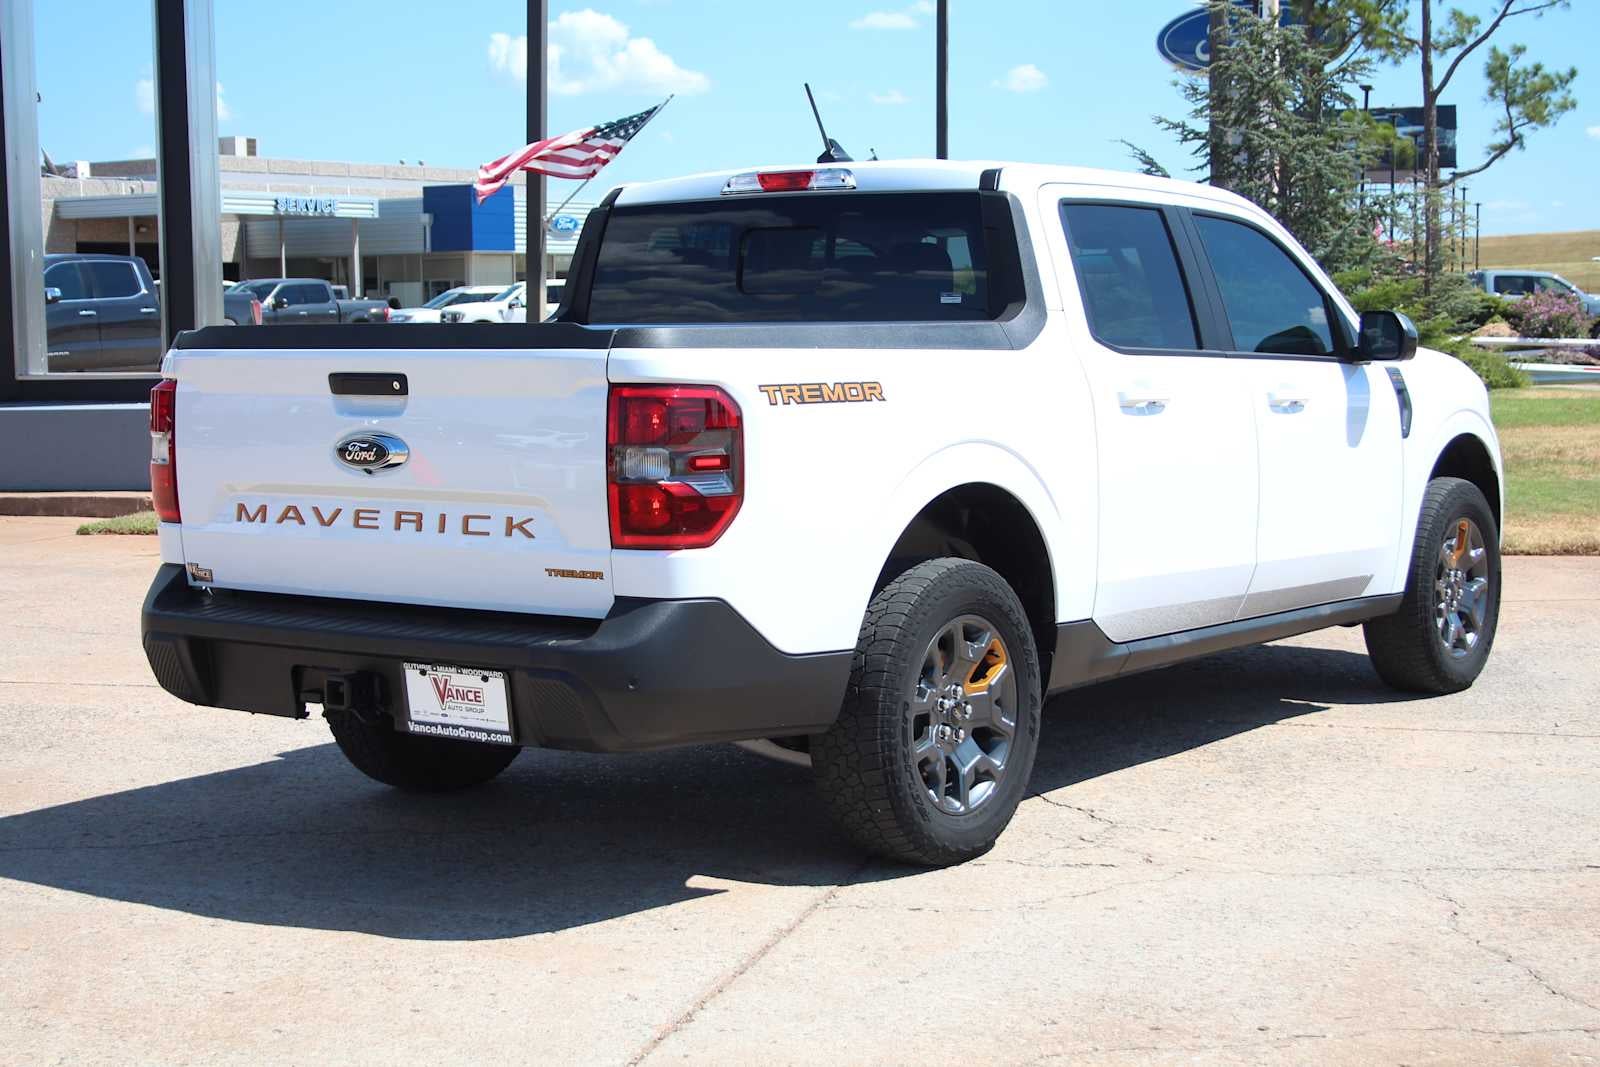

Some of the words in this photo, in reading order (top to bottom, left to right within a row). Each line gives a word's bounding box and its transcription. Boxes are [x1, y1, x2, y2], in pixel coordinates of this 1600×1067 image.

[276, 197, 337, 212] SERVICE
[758, 381, 886, 405] TREMOR
[345, 442, 377, 461] Ford
[236, 502, 536, 539] MAVERICK
[544, 568, 604, 580] TREMOR
[403, 662, 432, 672] GUTHRIE
[436, 665, 458, 674] MIAMI
[462, 668, 504, 679] WOODWARD
[429, 674, 484, 708] VANCE
[447, 704, 464, 712] AUTO
[465, 706, 485, 714] GROUP
[408, 720, 513, 744] VanceAutoGroup.com
